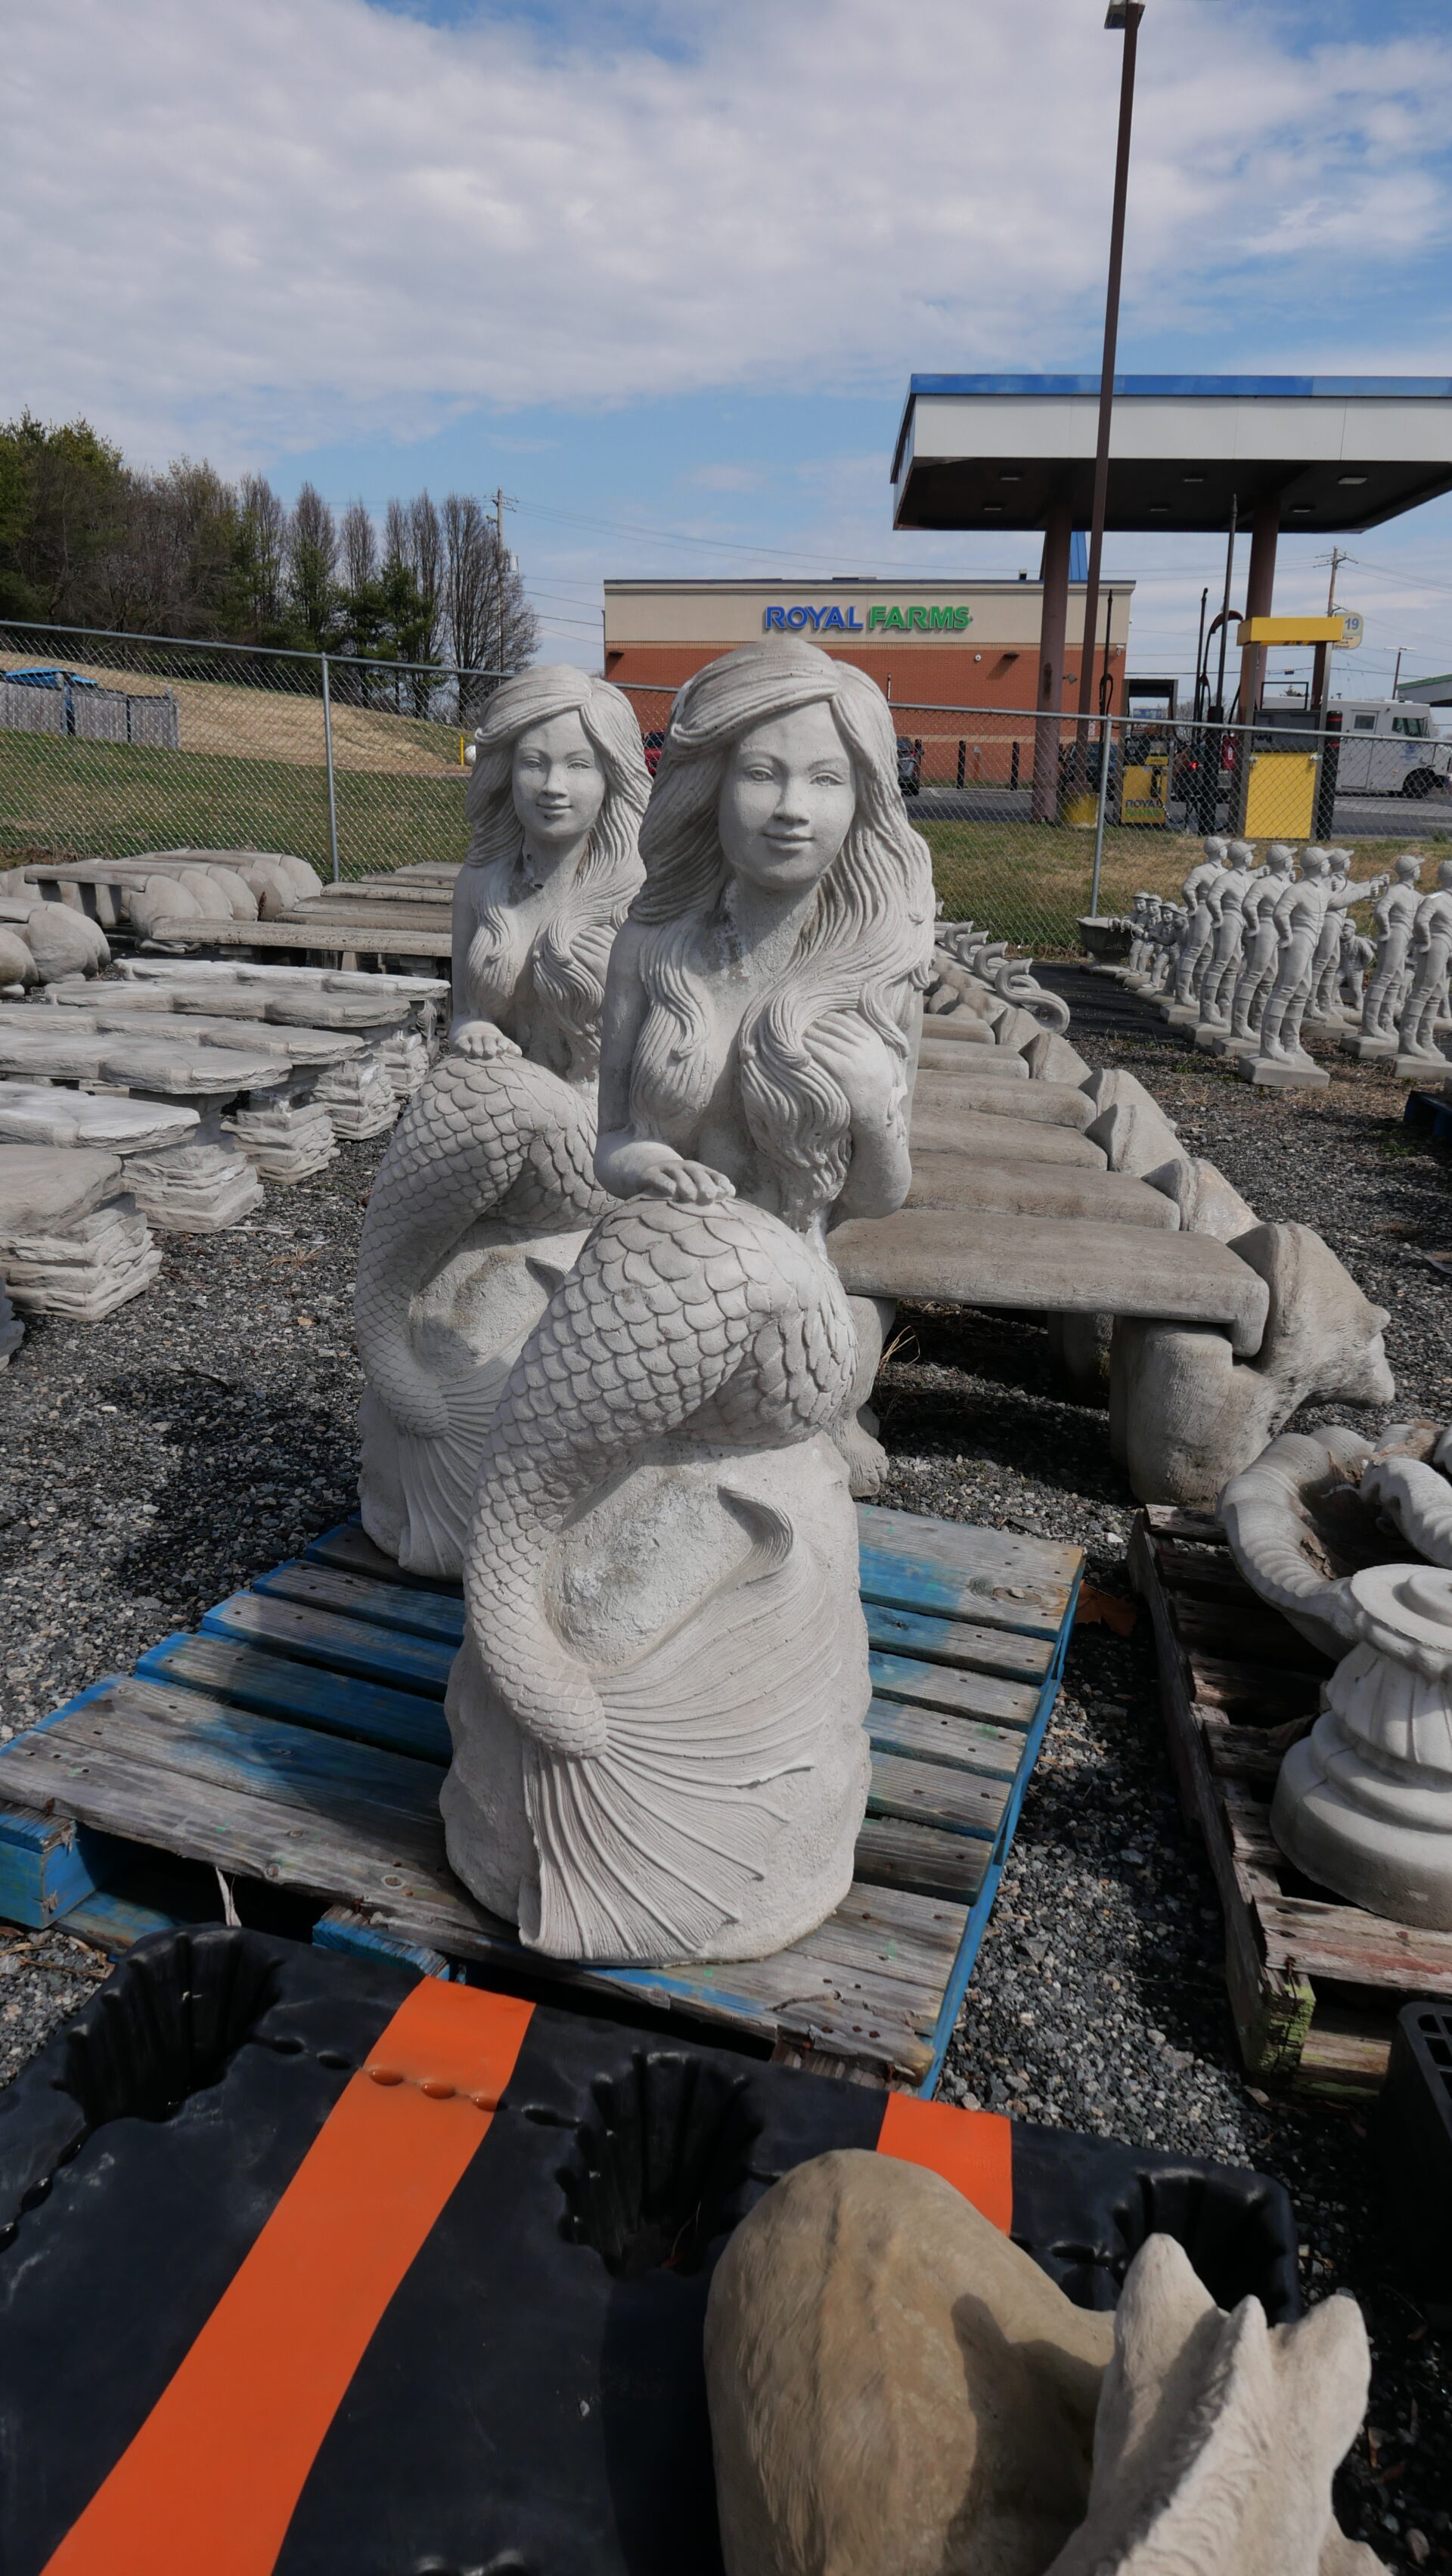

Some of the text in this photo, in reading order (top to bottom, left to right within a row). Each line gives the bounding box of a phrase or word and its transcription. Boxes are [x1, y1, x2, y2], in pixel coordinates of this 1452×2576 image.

[765, 606, 970, 629] ROYAL FARMS
[1345, 617, 1360, 630] 19
